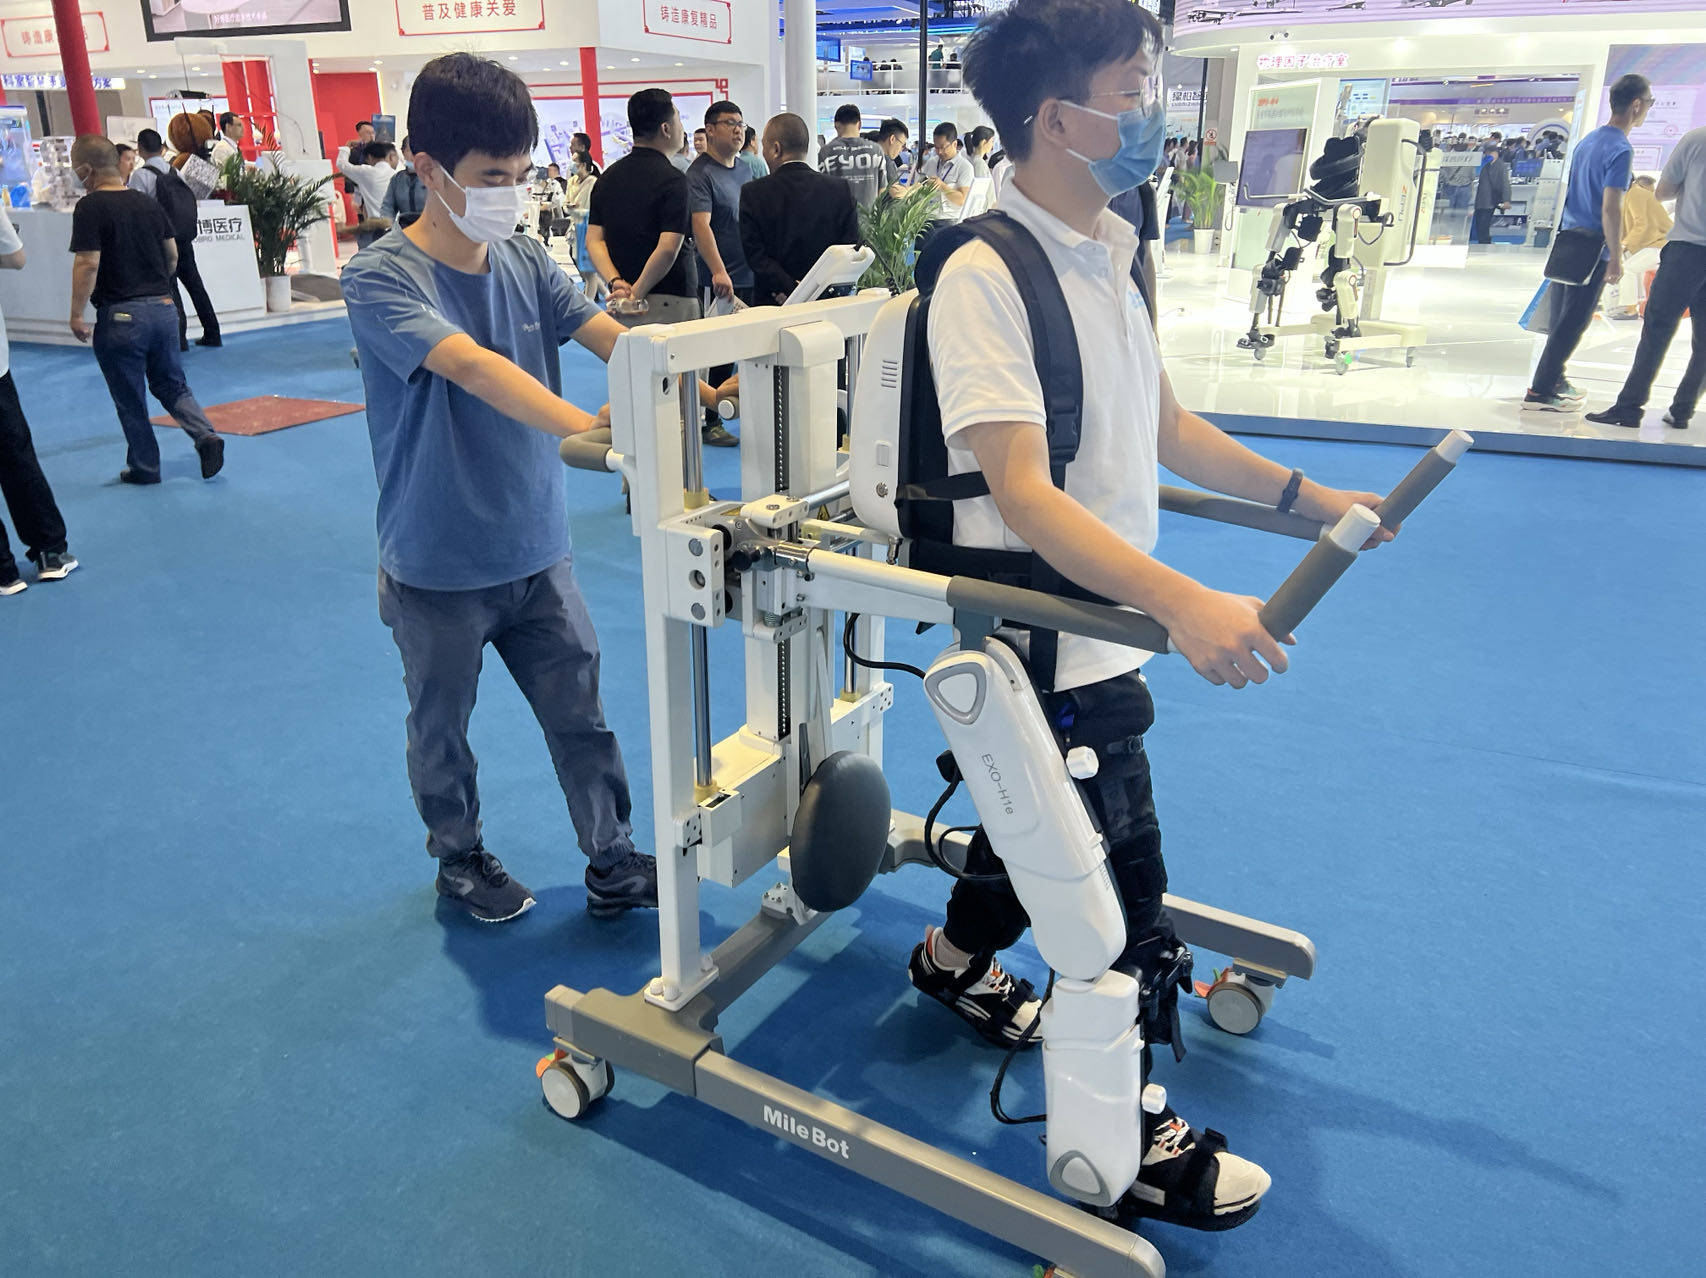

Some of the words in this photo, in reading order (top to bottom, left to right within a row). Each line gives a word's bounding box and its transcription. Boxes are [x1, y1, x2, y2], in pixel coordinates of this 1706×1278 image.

[422, 0, 517, 21] 普及健康关爱
[661, 5, 717, 29] 铸造康复精品
[981, 753, 1014, 815] EXO-H1e
[763, 1104, 850, 1160] MileBot
